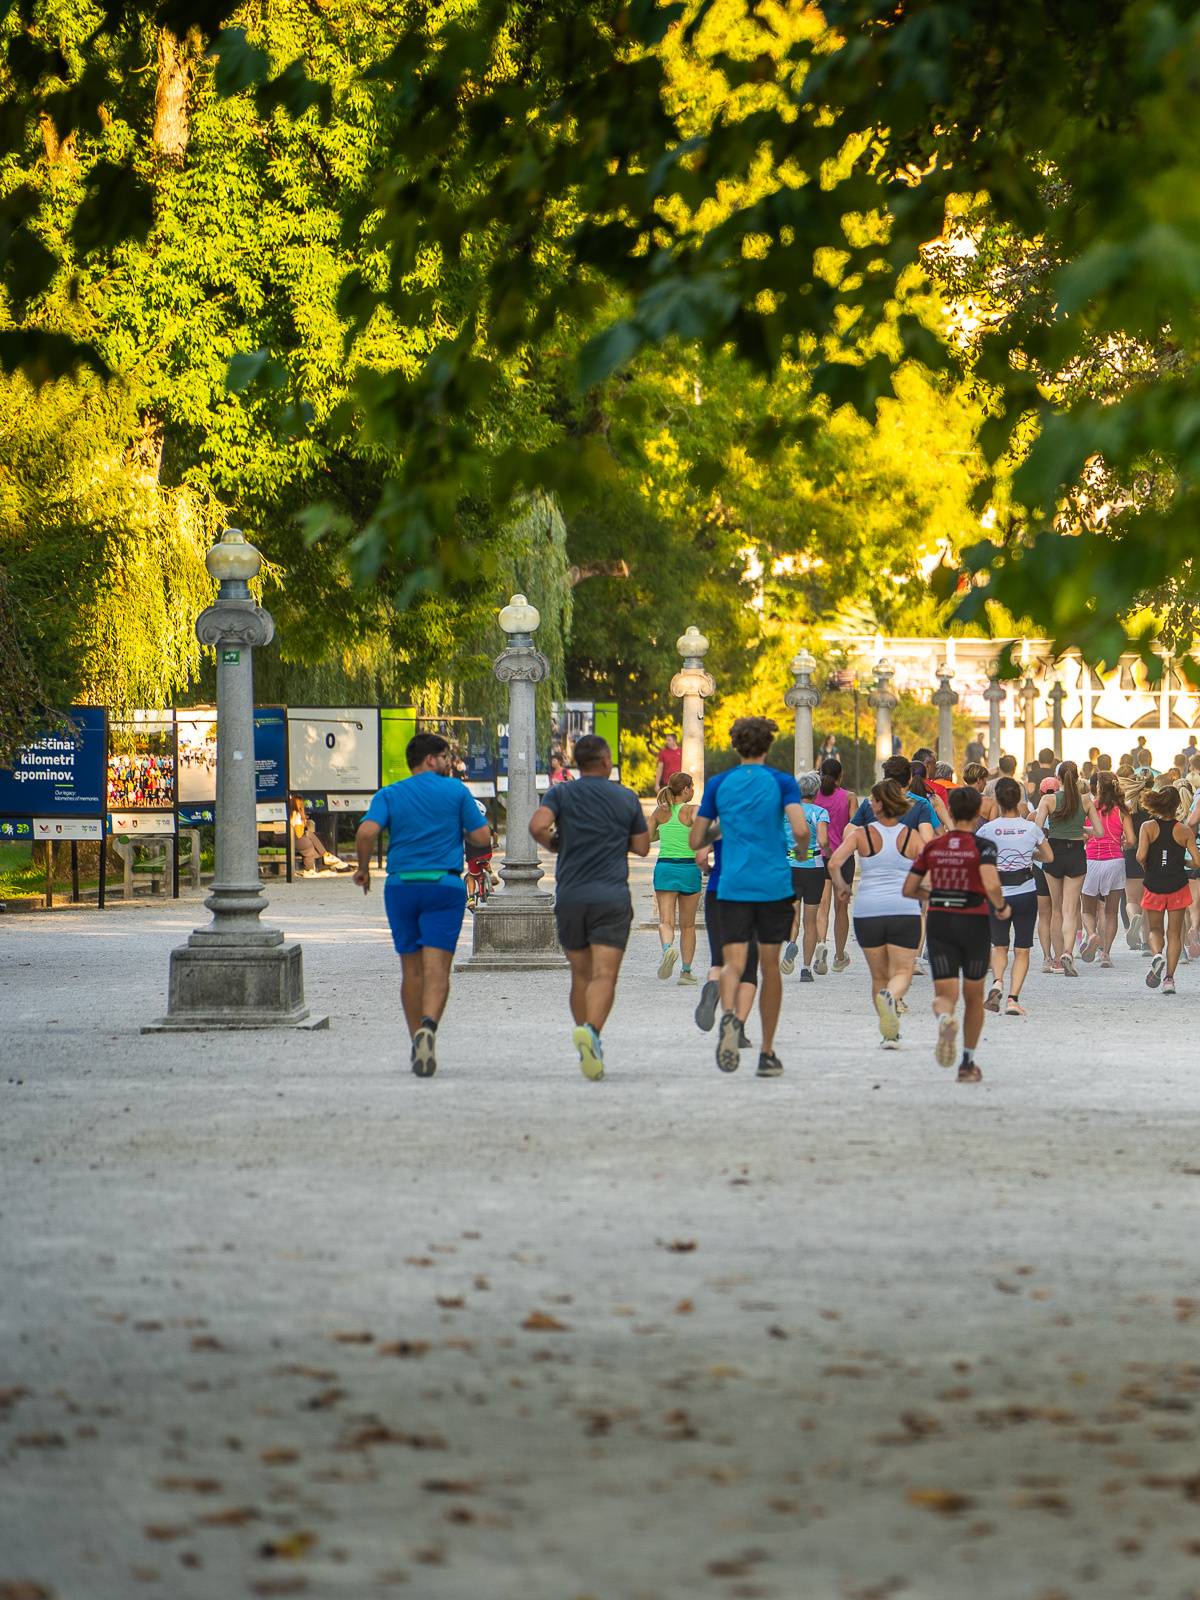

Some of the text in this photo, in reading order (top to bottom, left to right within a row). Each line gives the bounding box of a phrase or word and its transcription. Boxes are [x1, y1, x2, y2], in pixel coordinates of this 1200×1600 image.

[16, 738, 74, 752] apuščina:
[326, 732, 336, 749] 0
[21, 754, 74, 765] kilometri
[14, 769, 74, 782] spominov.
